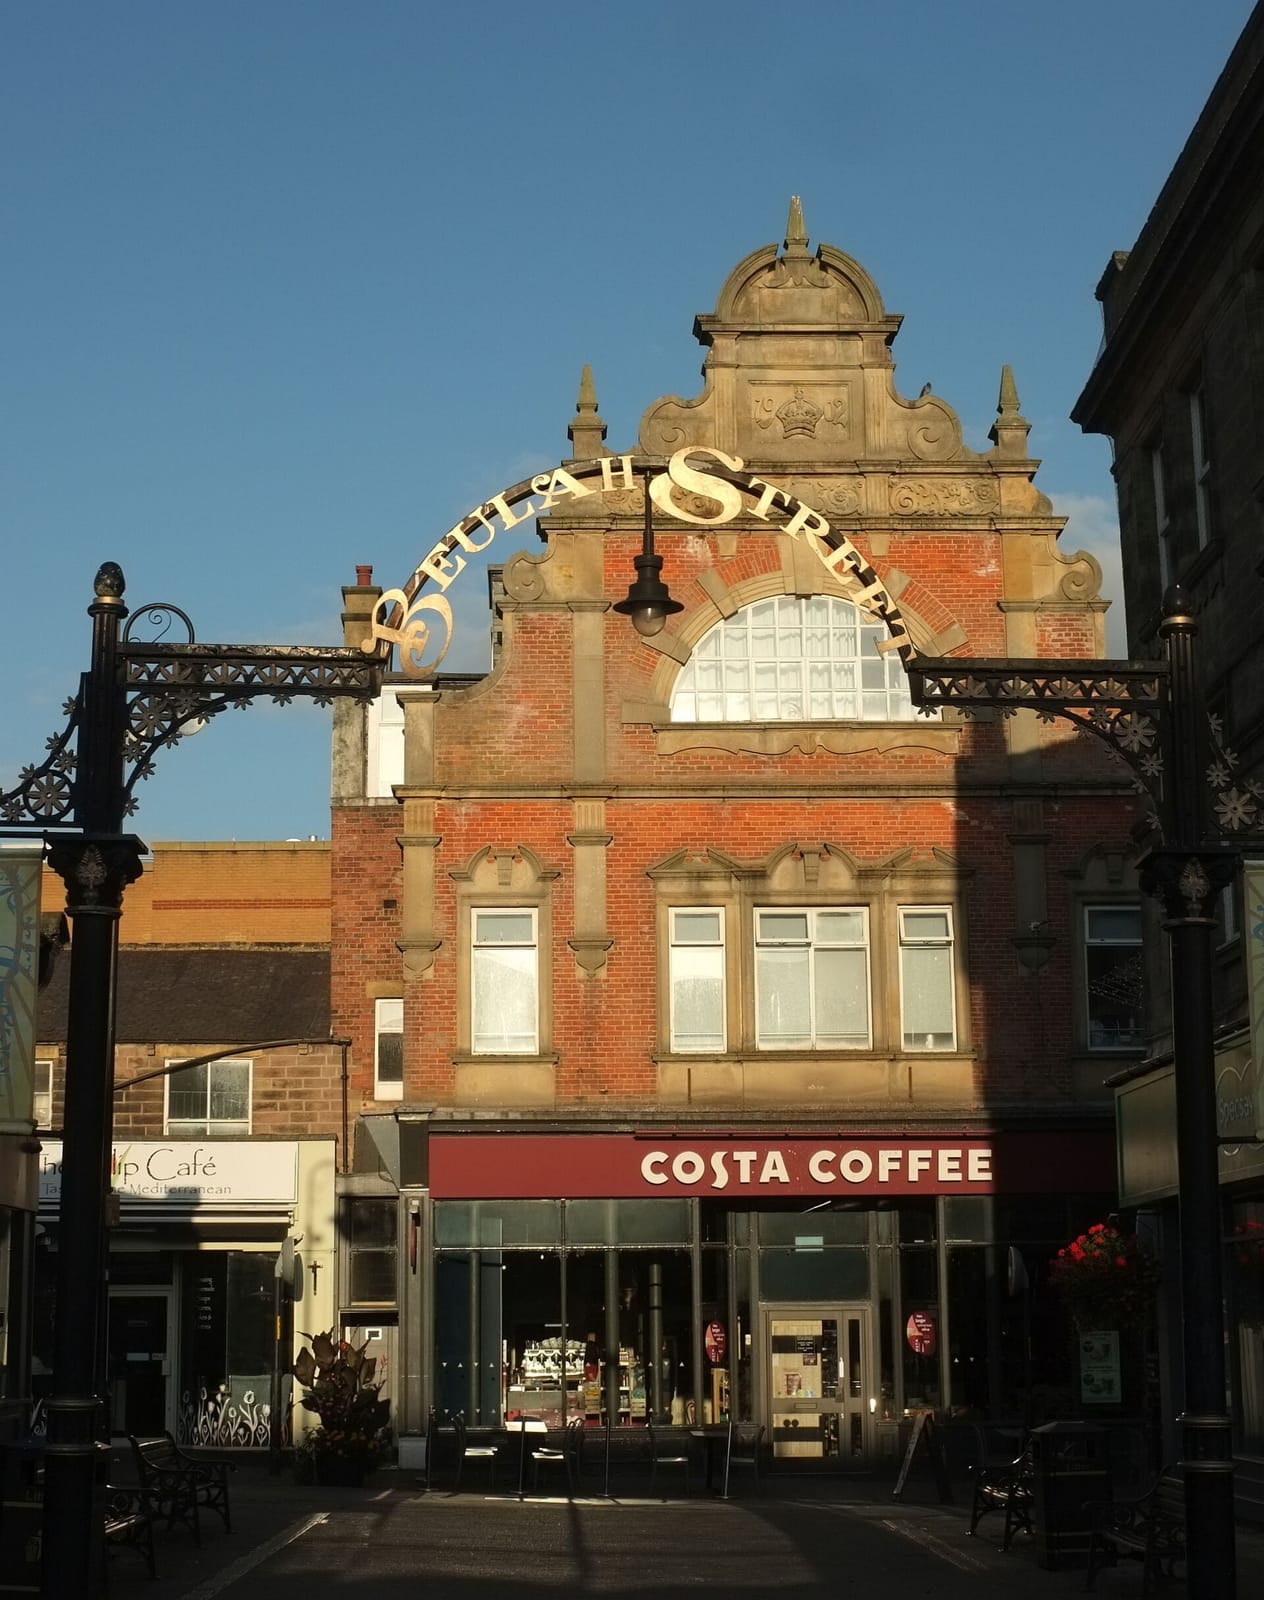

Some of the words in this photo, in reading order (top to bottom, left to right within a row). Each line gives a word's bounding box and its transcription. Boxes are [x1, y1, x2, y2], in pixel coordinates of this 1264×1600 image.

[361, 455, 638, 679] BEULAH
[649, 446, 917, 661] STREET
[112, 1148, 139, 1184] lip
[146, 1148, 217, 1181] Café
[641, 1151, 790, 1189] COSTA
[809, 1150, 992, 1183] COFFEE
[129, 1183, 232, 1196] Mediterranean
